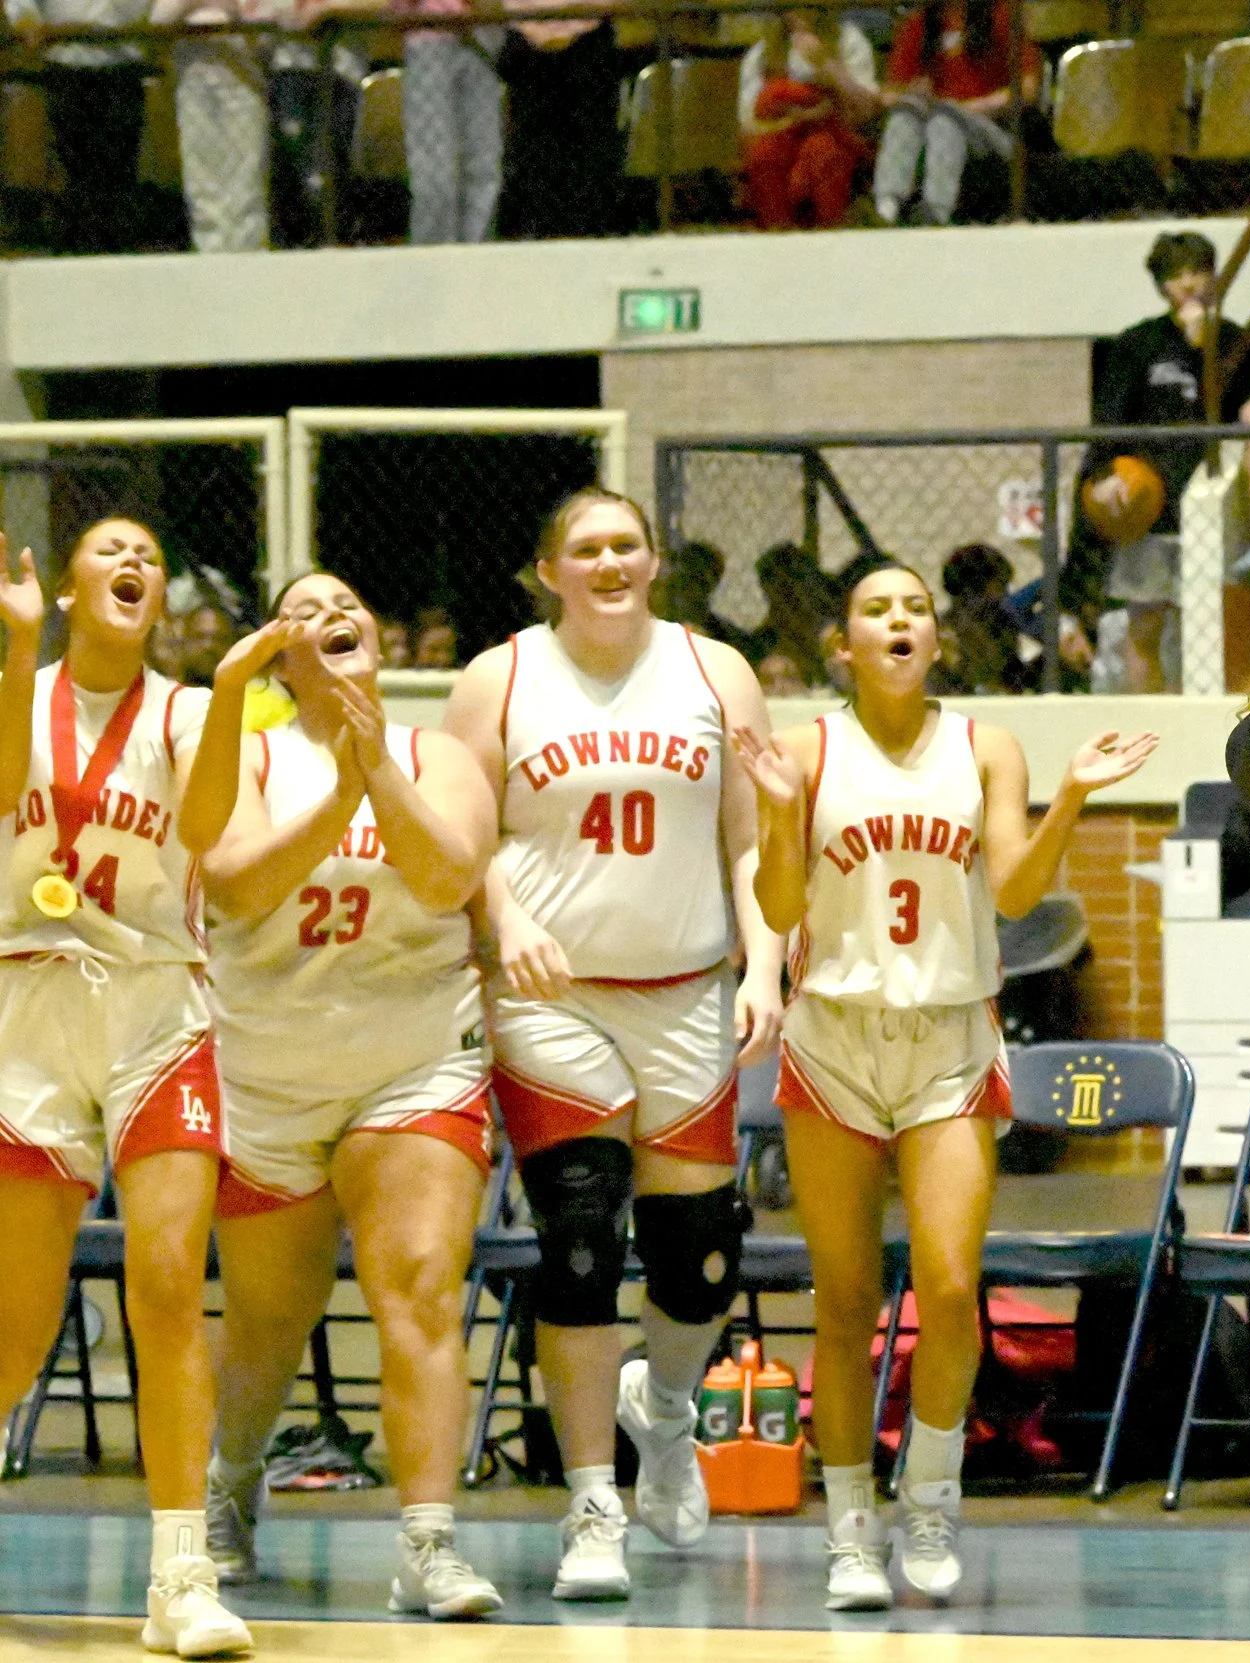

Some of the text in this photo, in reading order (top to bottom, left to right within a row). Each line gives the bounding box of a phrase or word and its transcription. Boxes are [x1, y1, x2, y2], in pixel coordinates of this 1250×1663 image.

[520, 731, 710, 792] LOWNDES
[15, 788, 172, 848] LONDES
[579, 790, 655, 856] 40
[823, 814, 979, 876] LOWNDES
[298, 885, 371, 946] 23
[889, 878, 921, 945] 3
[179, 1084, 212, 1134] LA
[704, 1406, 728, 1438] G
[758, 1411, 786, 1442] G
